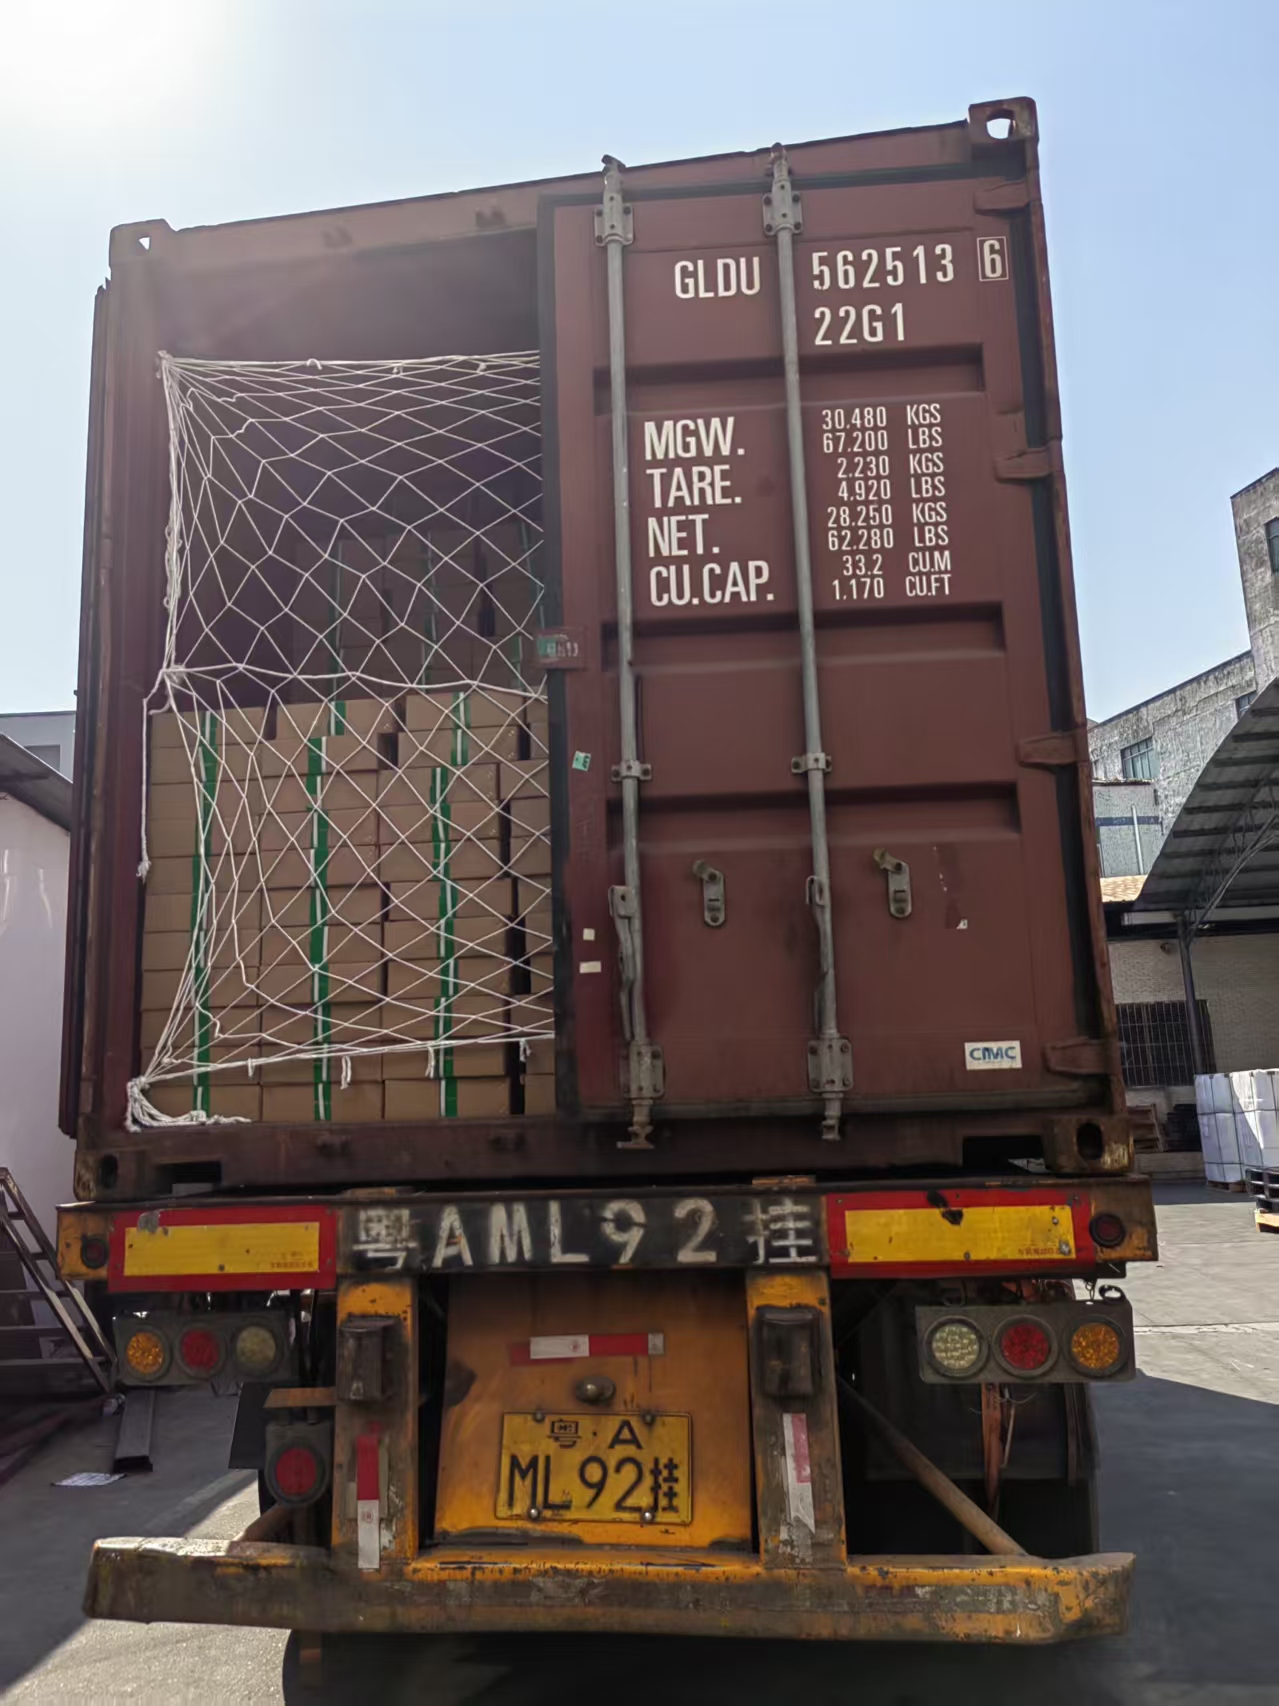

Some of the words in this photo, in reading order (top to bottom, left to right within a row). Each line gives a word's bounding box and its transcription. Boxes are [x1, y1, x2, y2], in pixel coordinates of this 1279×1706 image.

[674, 257, 761, 299] GLDU
[812, 244, 955, 291] 562513
[981, 238, 1005, 279] 6
[814, 303, 905, 346] 22G1
[821, 406, 887, 430] 30.480
[906, 403, 941, 426] KGS
[643, 416, 745, 461] MGW.
[822, 430, 888, 454] 67.200
[907, 427, 943, 449] LBS
[837, 456, 890, 479] 2.230
[909, 452, 944, 474] KGS
[645, 464, 743, 509] TARE.
[838, 479, 891, 502] 4.920
[910, 476, 946, 498] LBS
[827, 505, 893, 528] 28.250
[912, 502, 947, 524] KGS
[647, 514, 721, 559] NET.
[827, 528, 894, 551] 62.280
[913, 525, 949, 547] LBS
[842, 554, 883, 576] 33.2
[908, 550, 951, 573] CU.M
[649, 561, 775, 607] CU.CAP.
[832, 578, 885, 601] 1.170
[905, 574, 952, 597] CU.FT
